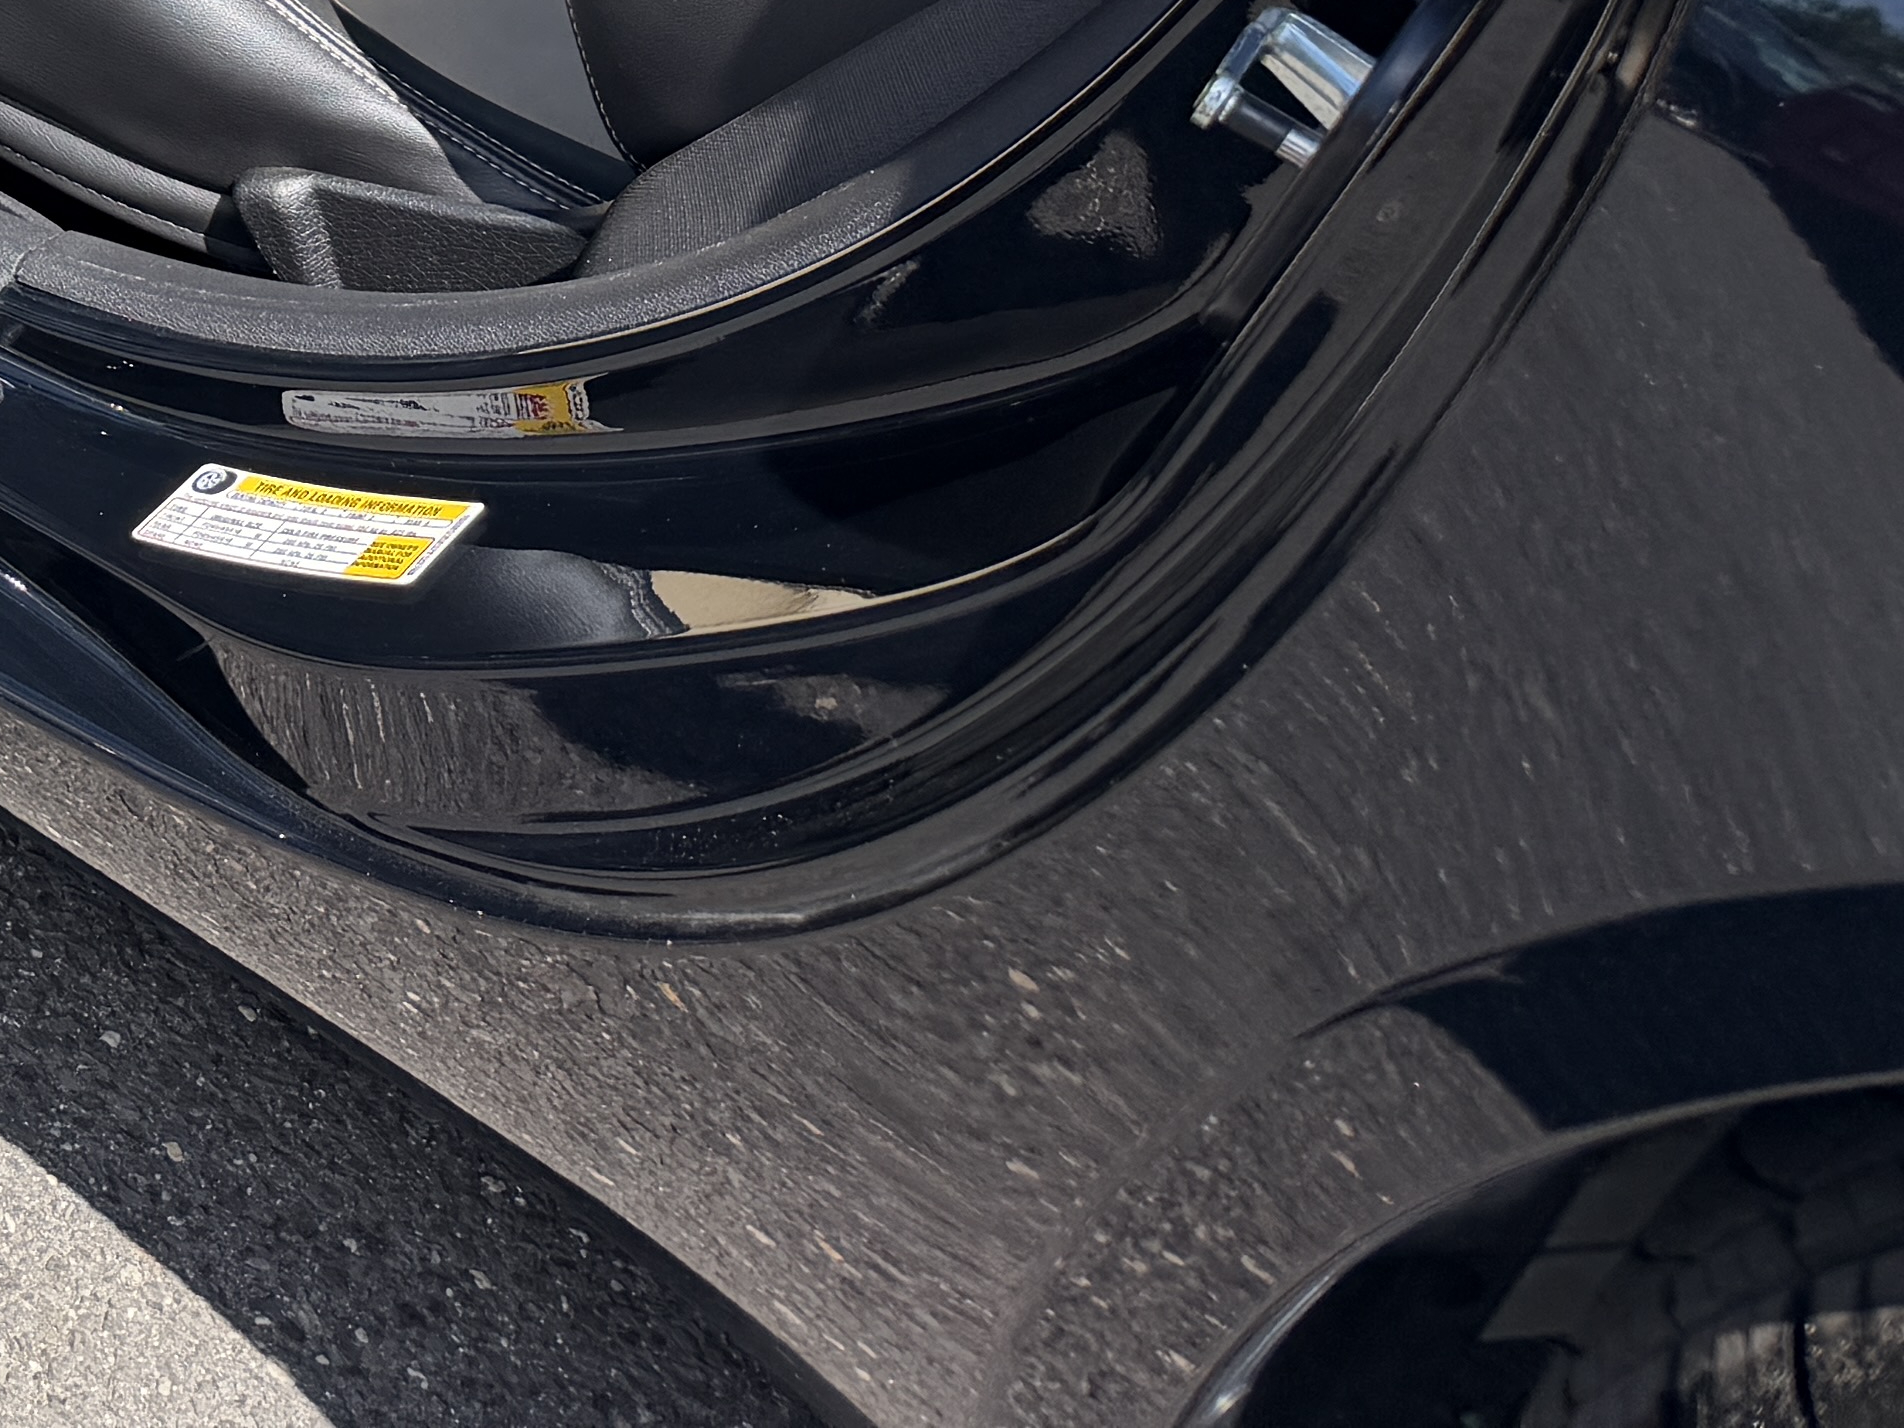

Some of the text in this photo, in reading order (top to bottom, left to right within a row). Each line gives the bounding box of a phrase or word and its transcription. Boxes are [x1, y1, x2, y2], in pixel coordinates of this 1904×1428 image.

[255, 480, 284, 495] TIRE
[283, 486, 310, 500] AND
[308, 490, 362, 509] LOADING
[359, 497, 443, 517] INFORMATION
